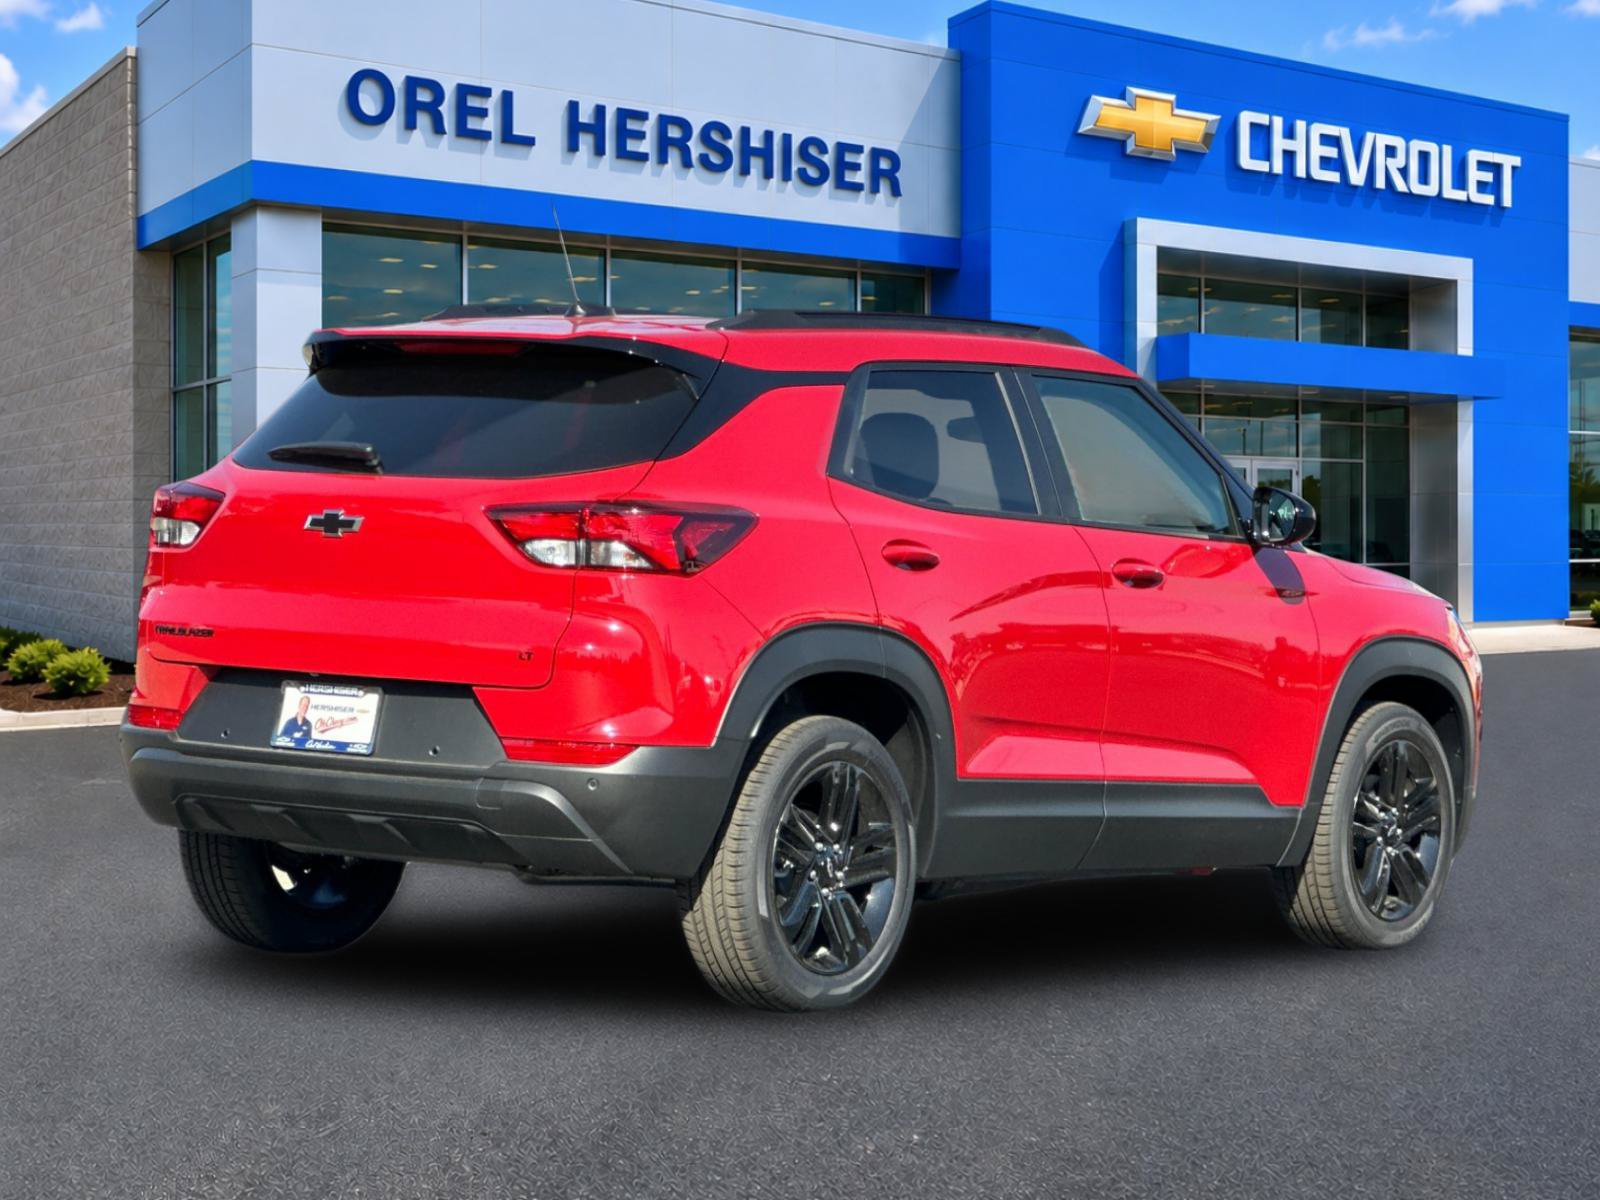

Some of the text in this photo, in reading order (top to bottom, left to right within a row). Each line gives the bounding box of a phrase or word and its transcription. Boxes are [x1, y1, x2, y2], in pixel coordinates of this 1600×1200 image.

[346, 69, 903, 197] OREL HERSHISER
[1237, 110, 1521, 208] CHEVROLET
[155, 625, 214, 637] TRAILBLAZER
